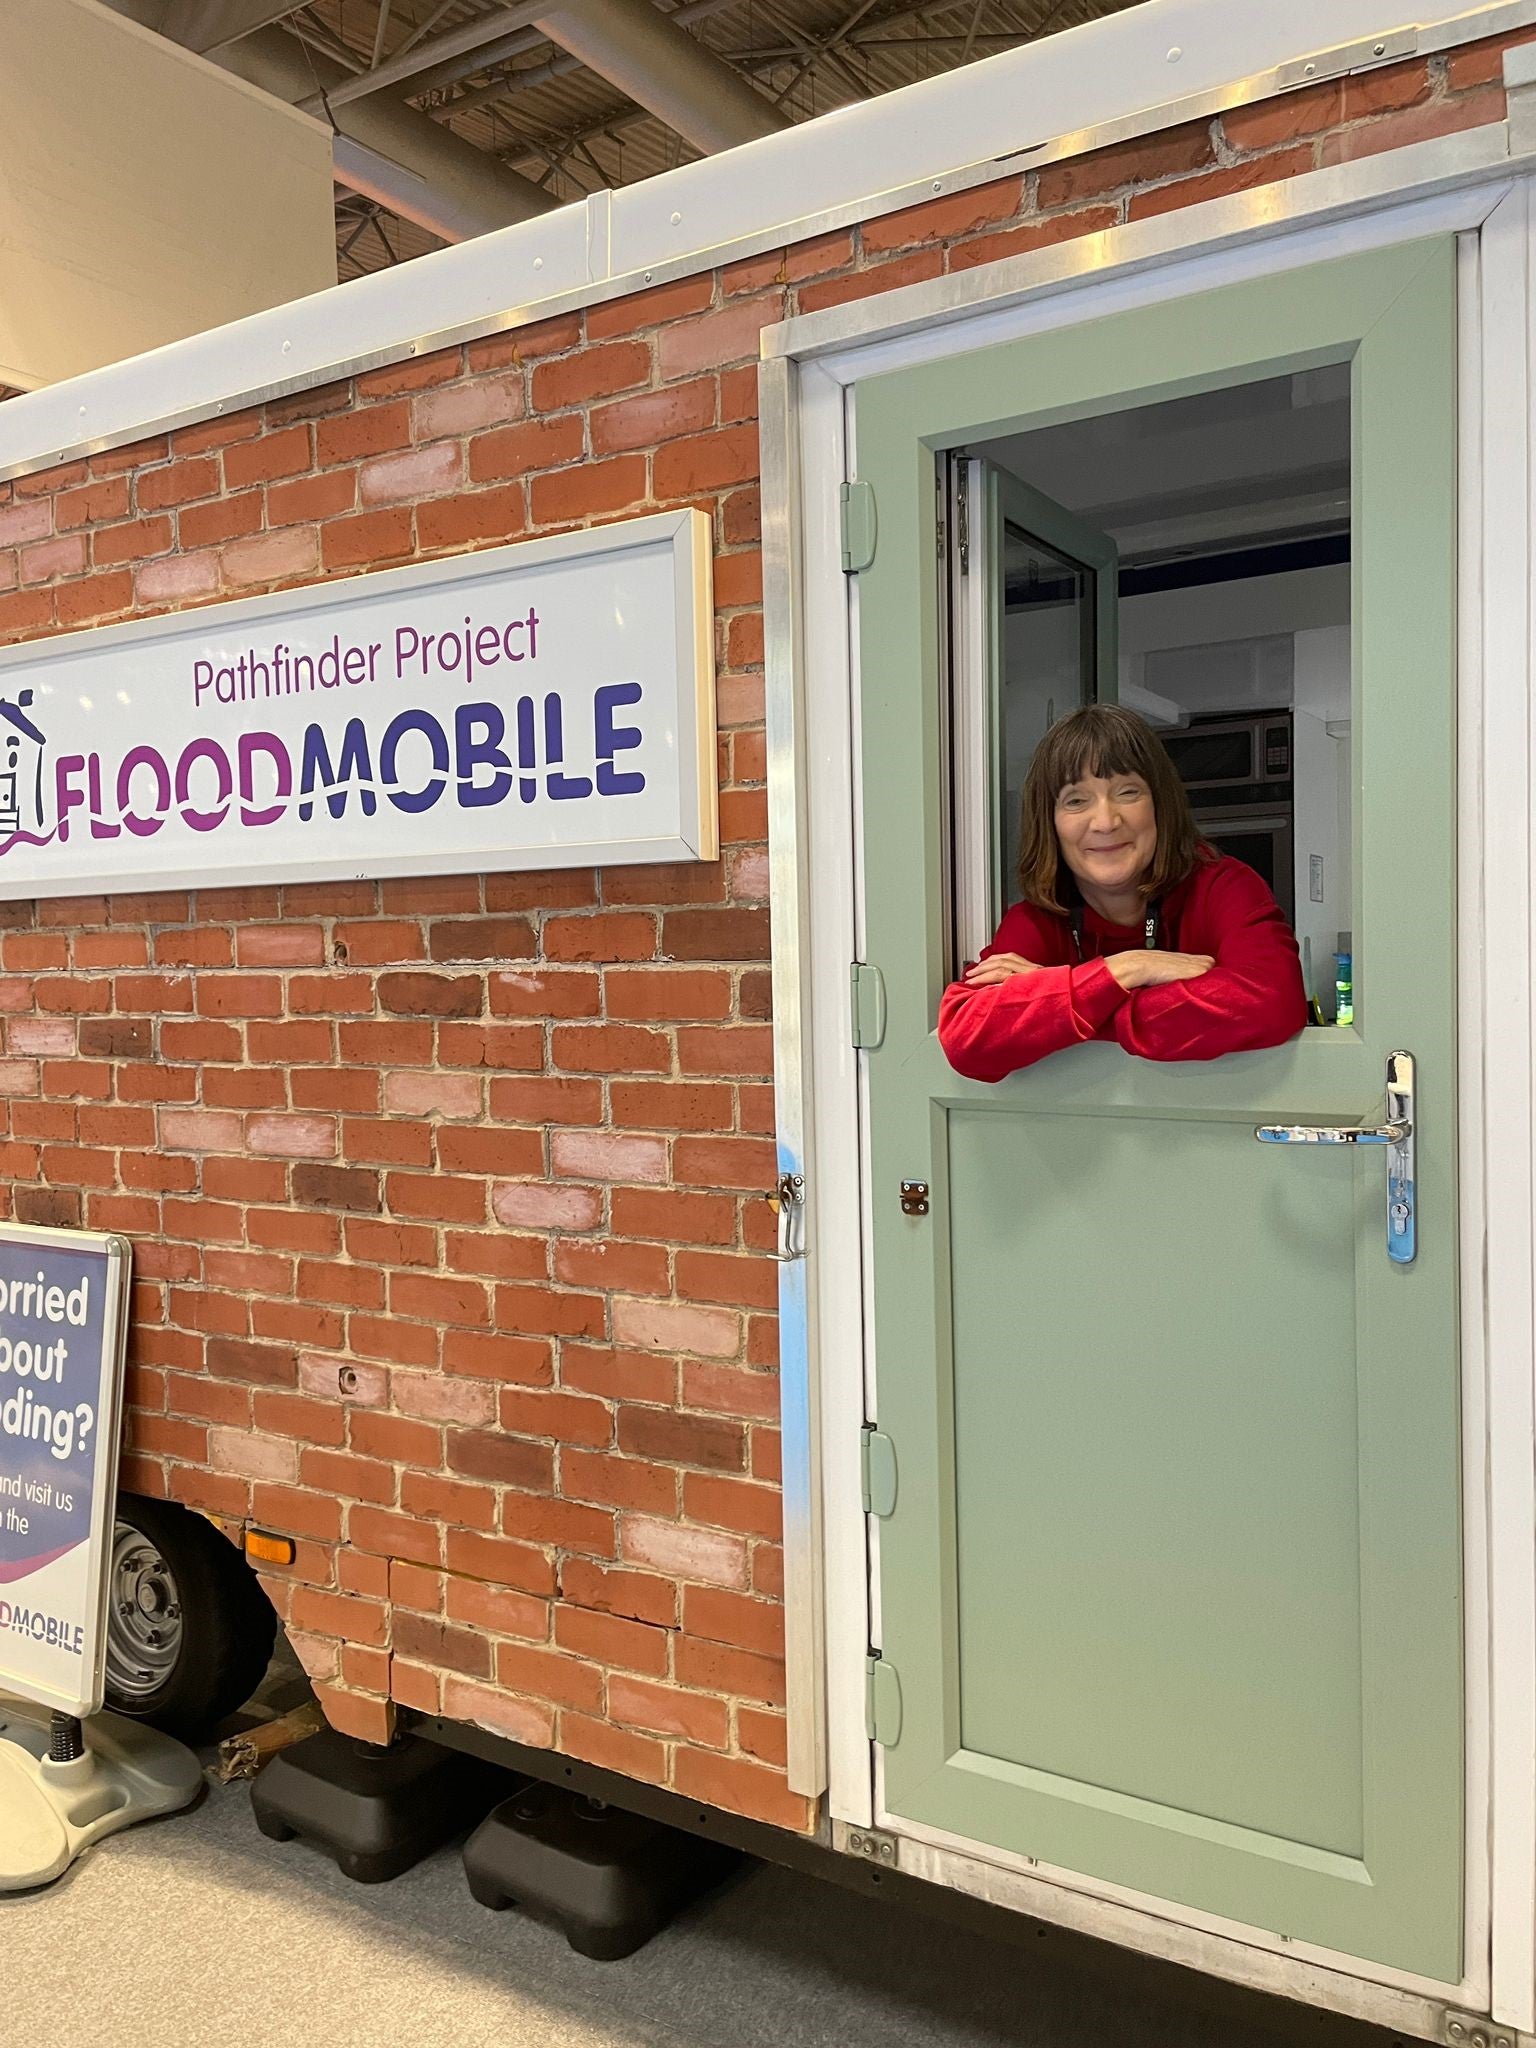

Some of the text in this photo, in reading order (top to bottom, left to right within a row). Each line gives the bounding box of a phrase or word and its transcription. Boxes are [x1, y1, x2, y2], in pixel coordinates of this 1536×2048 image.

[194, 607, 540, 707] Pathfinder Project
[55, 682, 646, 843] FLOODMOBILE
[0, 1386, 94, 1460] ding?
[0, 1474, 73, 1513] nd visit us
[6, 1507, 29, 1535] the
